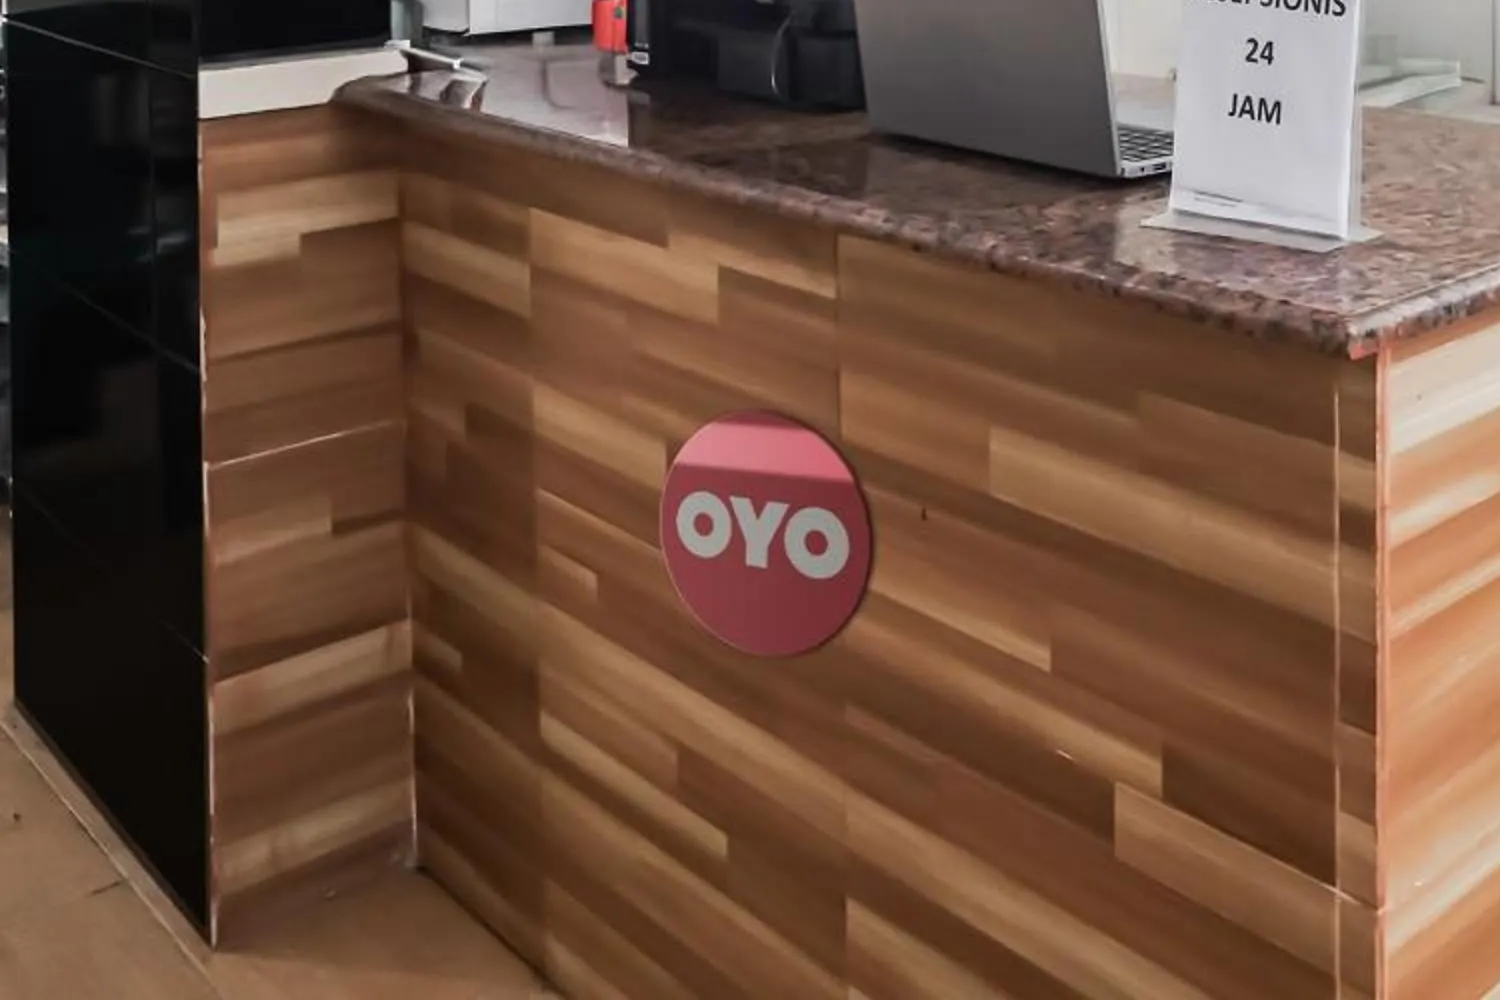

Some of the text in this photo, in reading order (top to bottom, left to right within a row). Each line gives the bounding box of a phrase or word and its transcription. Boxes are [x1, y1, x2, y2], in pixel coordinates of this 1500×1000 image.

[1244, 37, 1274, 66] 24
[1228, 93, 1281, 125] JAM
[676, 490, 850, 580] OYO
